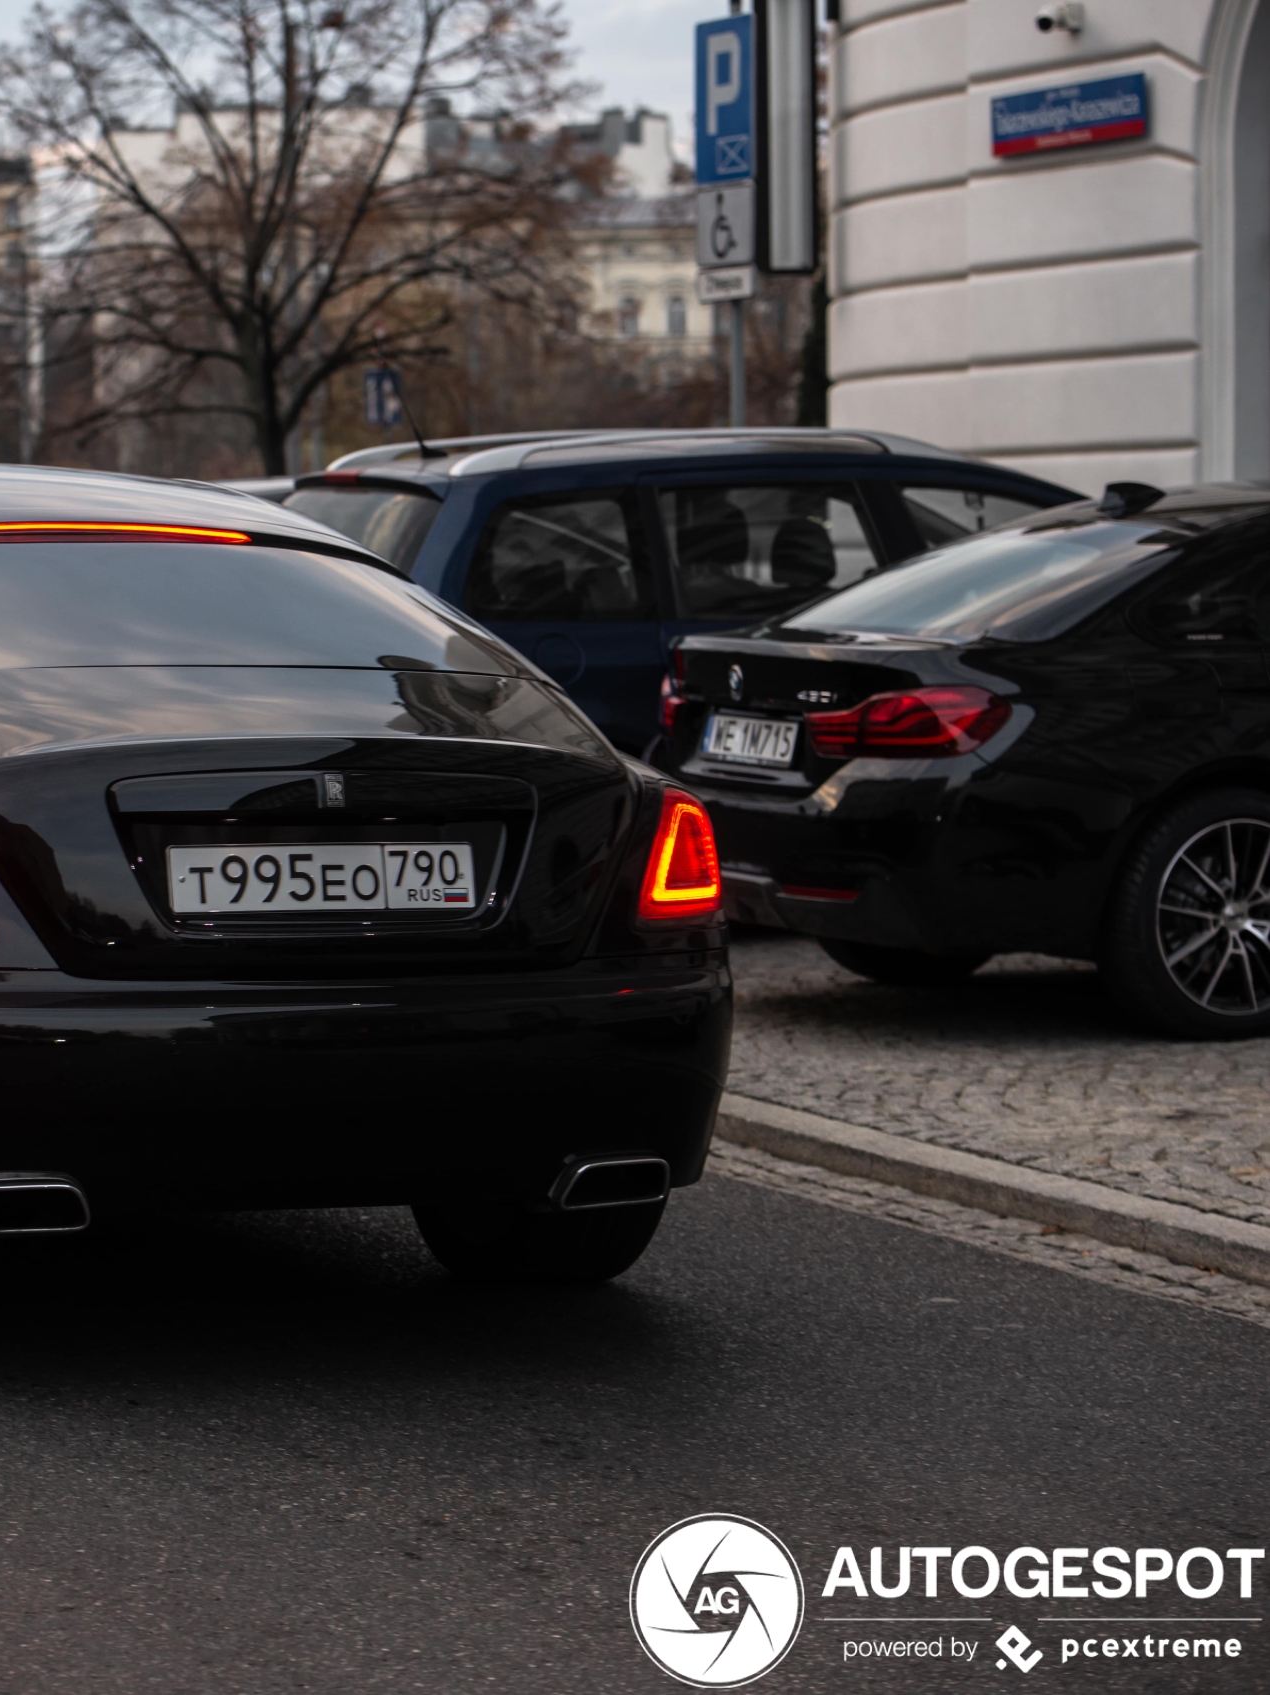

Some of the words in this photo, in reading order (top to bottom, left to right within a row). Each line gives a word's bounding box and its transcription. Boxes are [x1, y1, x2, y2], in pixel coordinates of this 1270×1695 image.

[706, 31, 741, 136] P
[388, 850, 459, 886] 790
[408, 889, 443, 902] RUS
